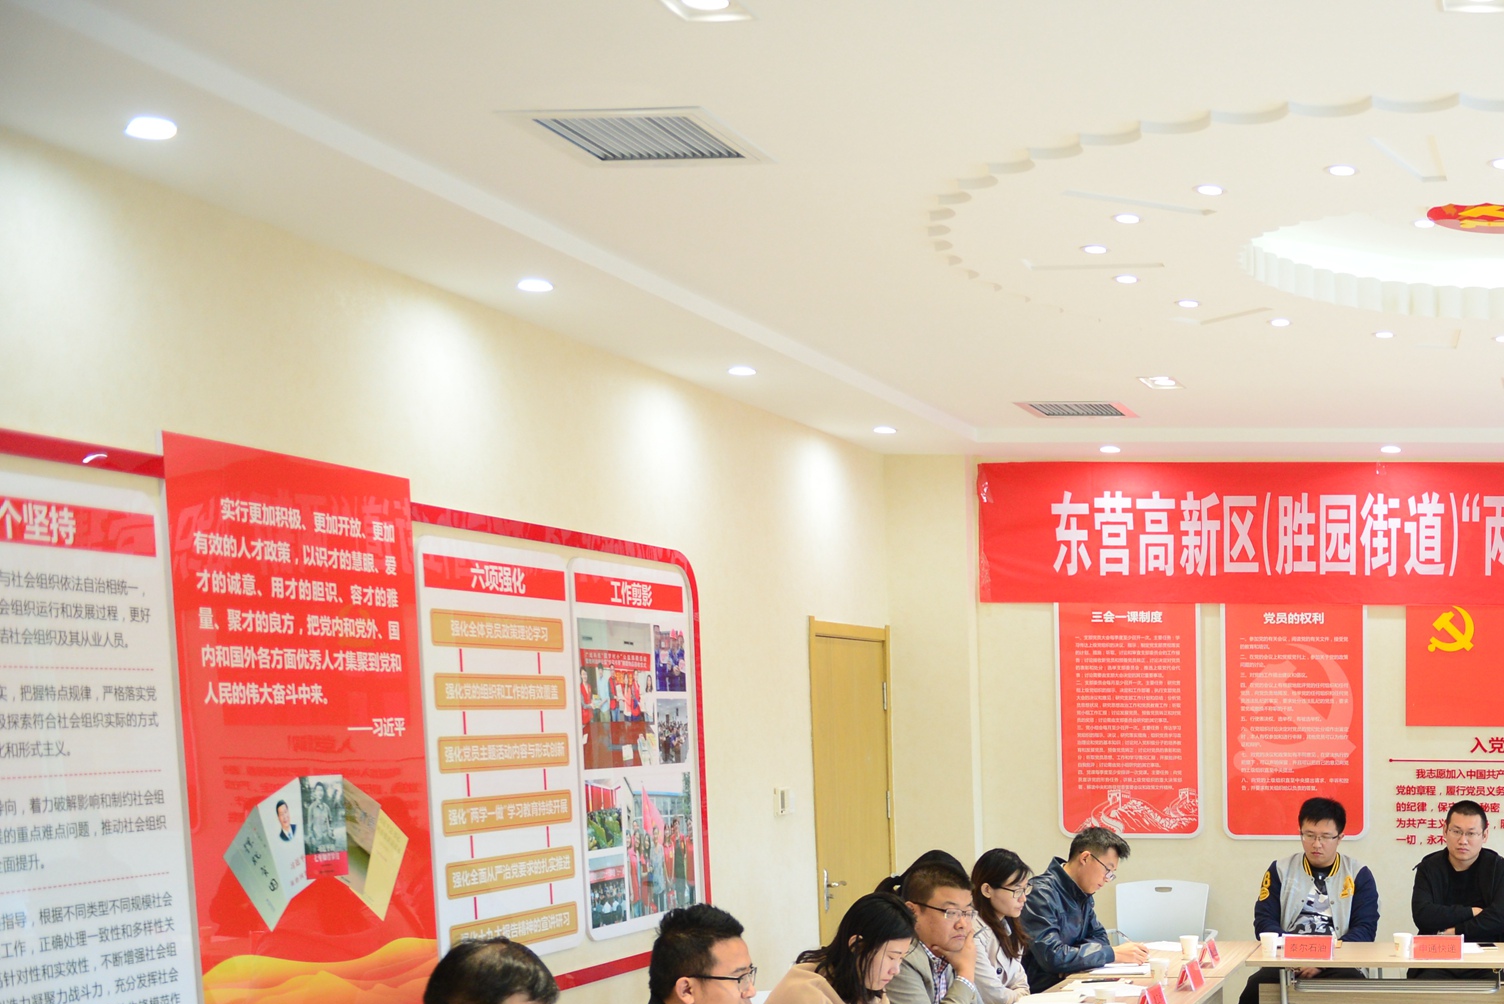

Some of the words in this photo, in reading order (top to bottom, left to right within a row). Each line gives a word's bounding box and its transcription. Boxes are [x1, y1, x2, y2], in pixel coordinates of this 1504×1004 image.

[0, 500, 77, 545] 个坚持
[221, 498, 395, 543] 实行更加积极、更加开放、更加
[194, 531, 397, 576] 有效的人才政策，以识才的慧眼、爱
[196, 569, 399, 608] 才的诚意、用才的胆识、容才的雅
[470, 563, 526, 595] 六项强化
[610, 581, 652, 607] 工作剪影
[199, 607, 400, 640] 量、聚才的良方，把党内和党外、国
[1091, 611, 1163, 623] 三会一课制度
[1263, 612, 1325, 624] 党员的权利
[202, 644, 402, 673] 内和国外各方面优秀人才集聚到党和
[204, 682, 328, 705] 人民的伟大奋斗中来。
[0, 853, 45, 874] 面提升。
[0, 942, 178, 989] 针对性和实效性，不断增强社会组
